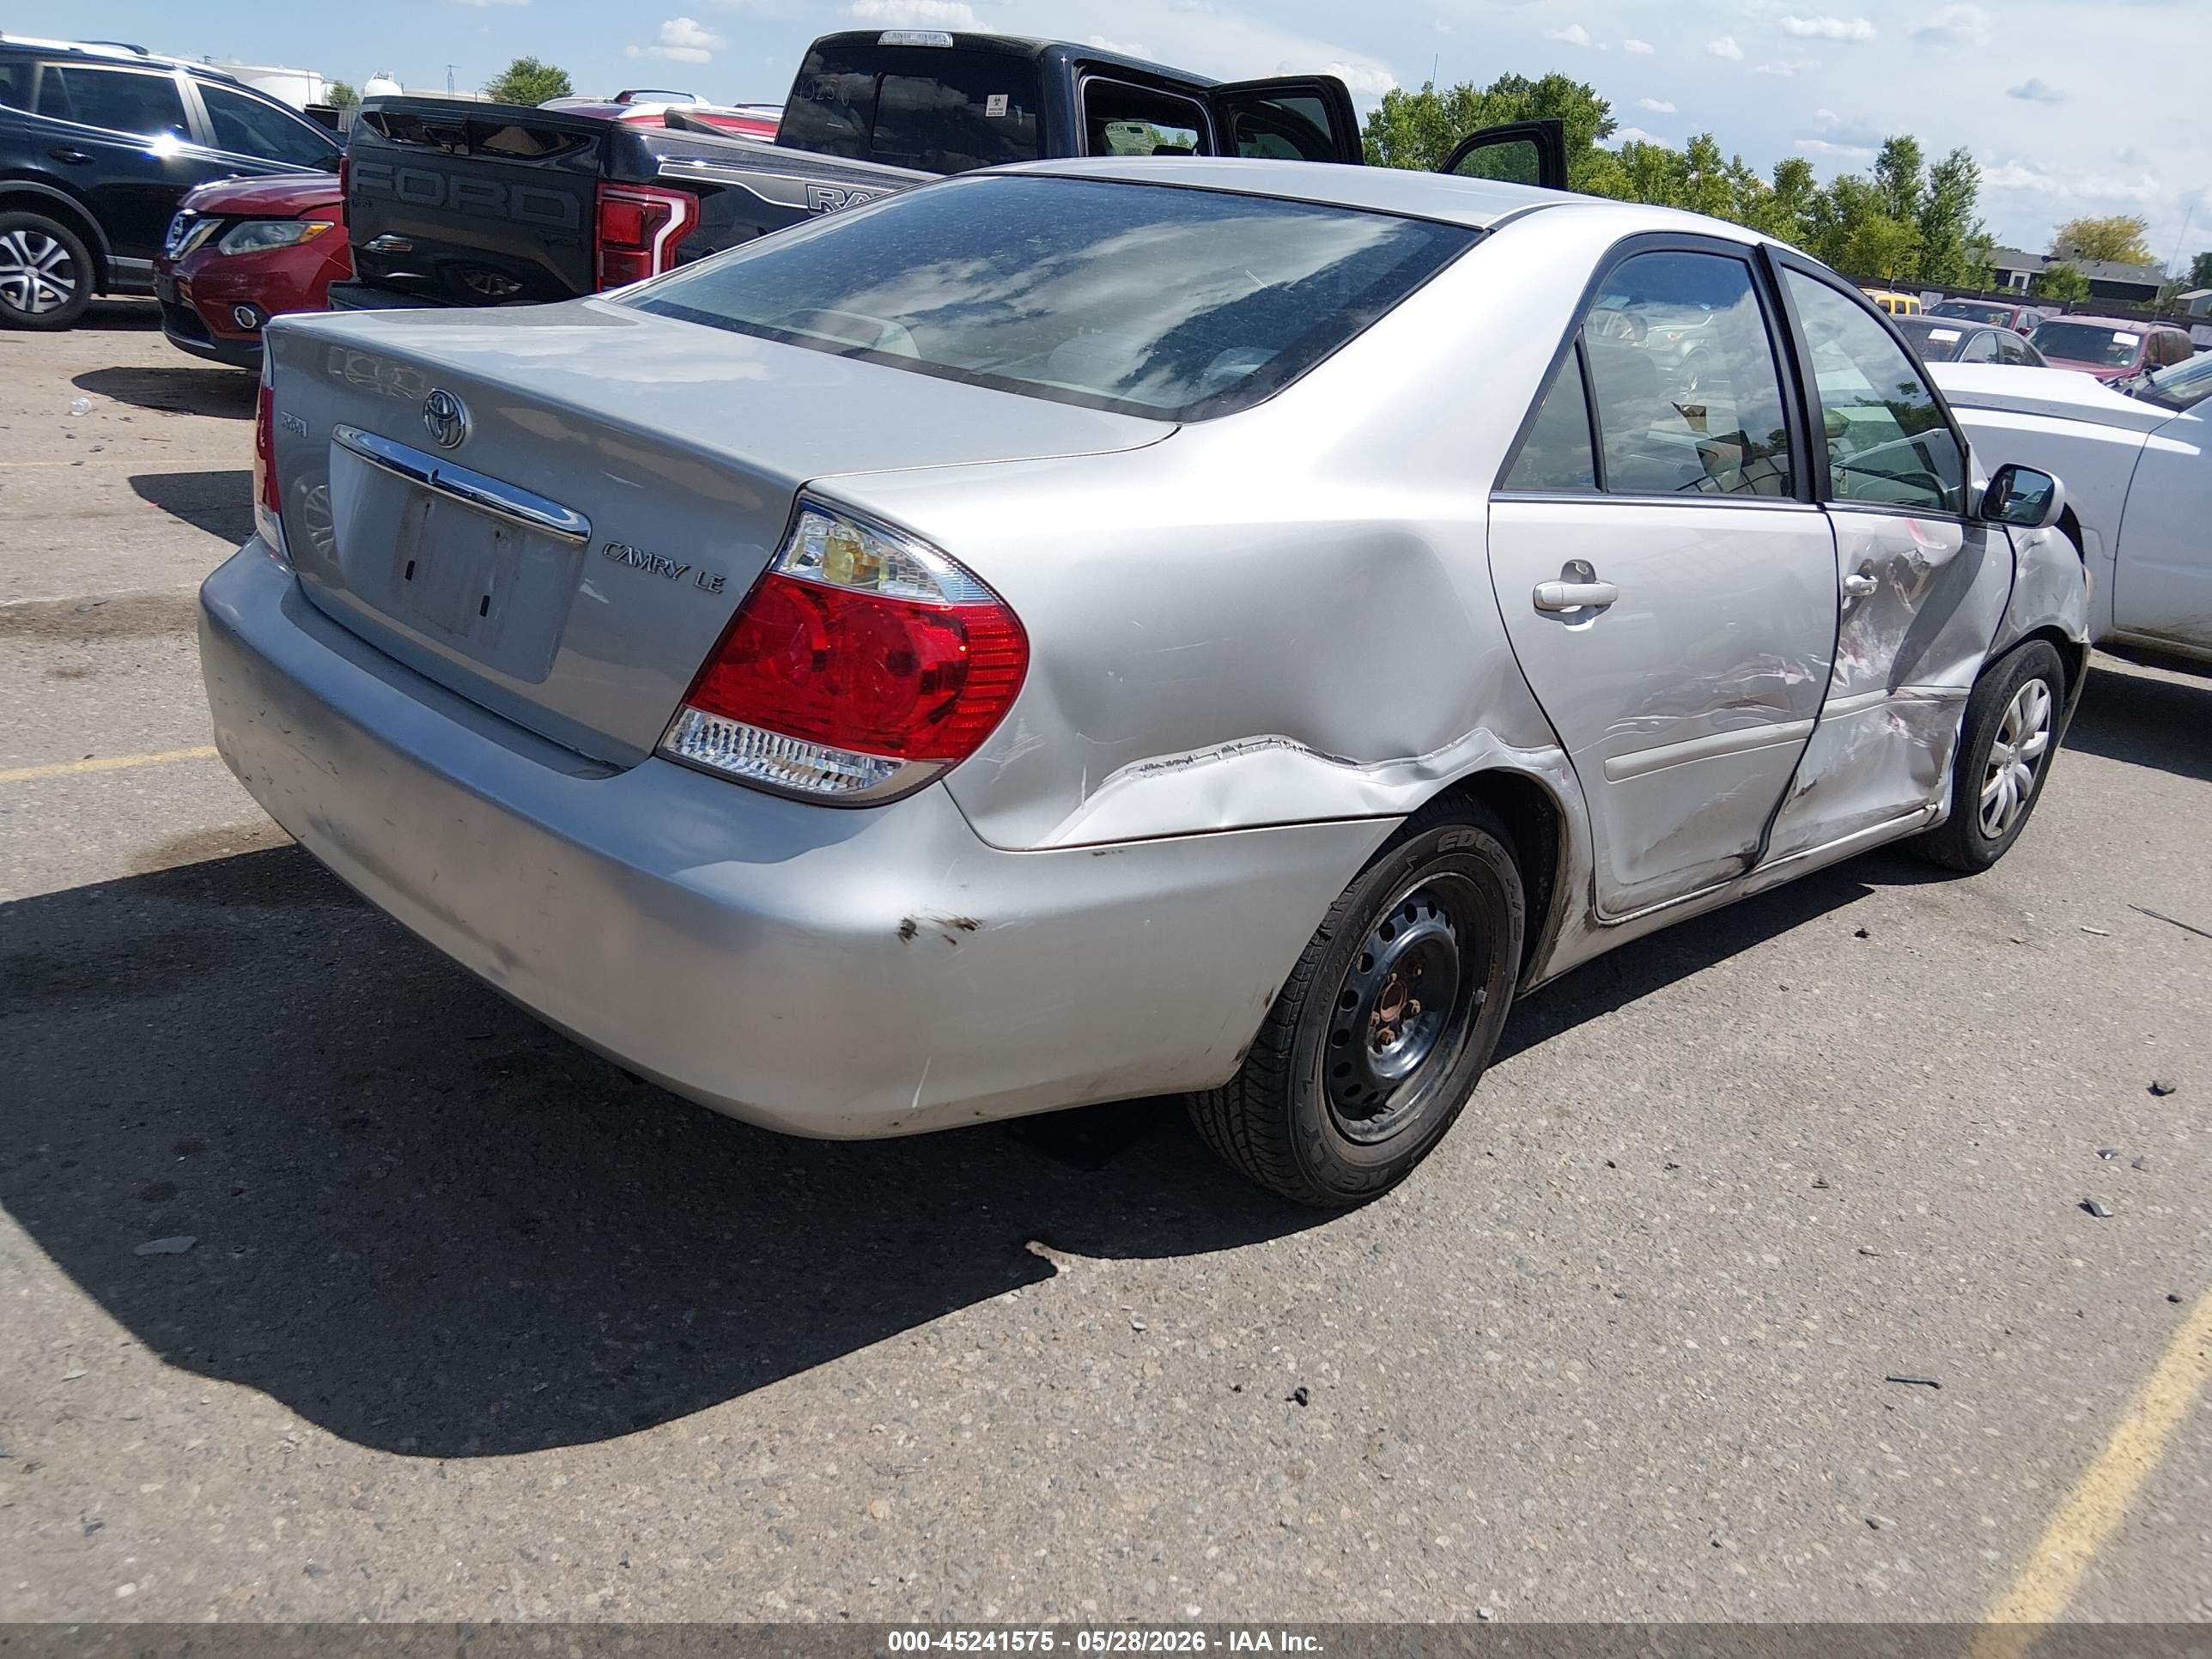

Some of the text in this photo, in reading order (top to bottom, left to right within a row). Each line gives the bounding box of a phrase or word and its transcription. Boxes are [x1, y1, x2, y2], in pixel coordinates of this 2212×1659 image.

[349, 161, 581, 231] FORD
[806, 184, 872, 213] RA
[603, 541, 726, 594] CAMRY LE
[1437, 830, 1506, 866] EDGE
